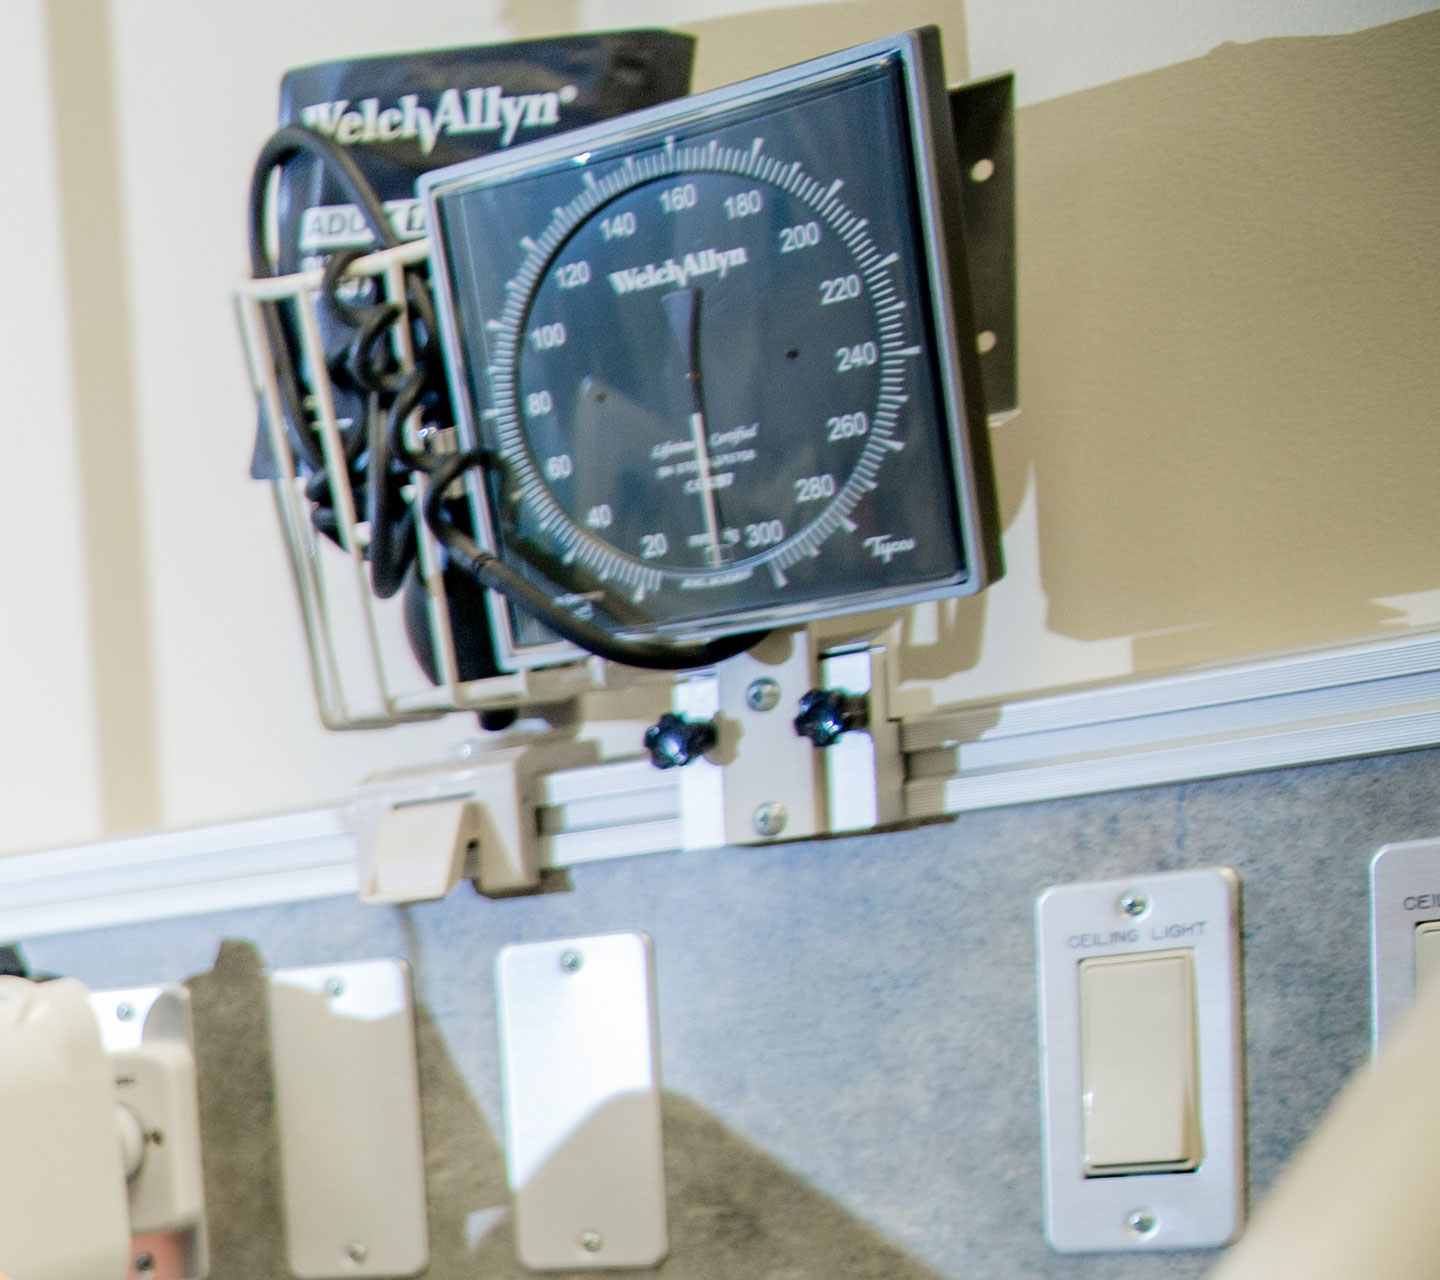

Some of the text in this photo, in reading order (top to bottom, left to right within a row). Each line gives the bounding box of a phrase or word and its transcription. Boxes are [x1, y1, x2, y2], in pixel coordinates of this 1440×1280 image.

[660, 184, 697, 213] 160
[725, 189, 762, 219] 180
[600, 212, 635, 241] 140
[779, 221, 821, 254] 200
[555, 260, 591, 290] 120
[820, 274, 860, 306] 220
[530, 322, 567, 350] 100
[836, 341, 877, 373] 240
[526, 390, 553, 417] 80
[826, 411, 868, 442] 260
[546, 454, 573, 481] 60
[794, 473, 836, 504] 280
[587, 504, 614, 530] 40
[640, 532, 668, 560] 20
[745, 518, 784, 549] 300
[1067, 920, 1208, 951] CEILING LIGHT
